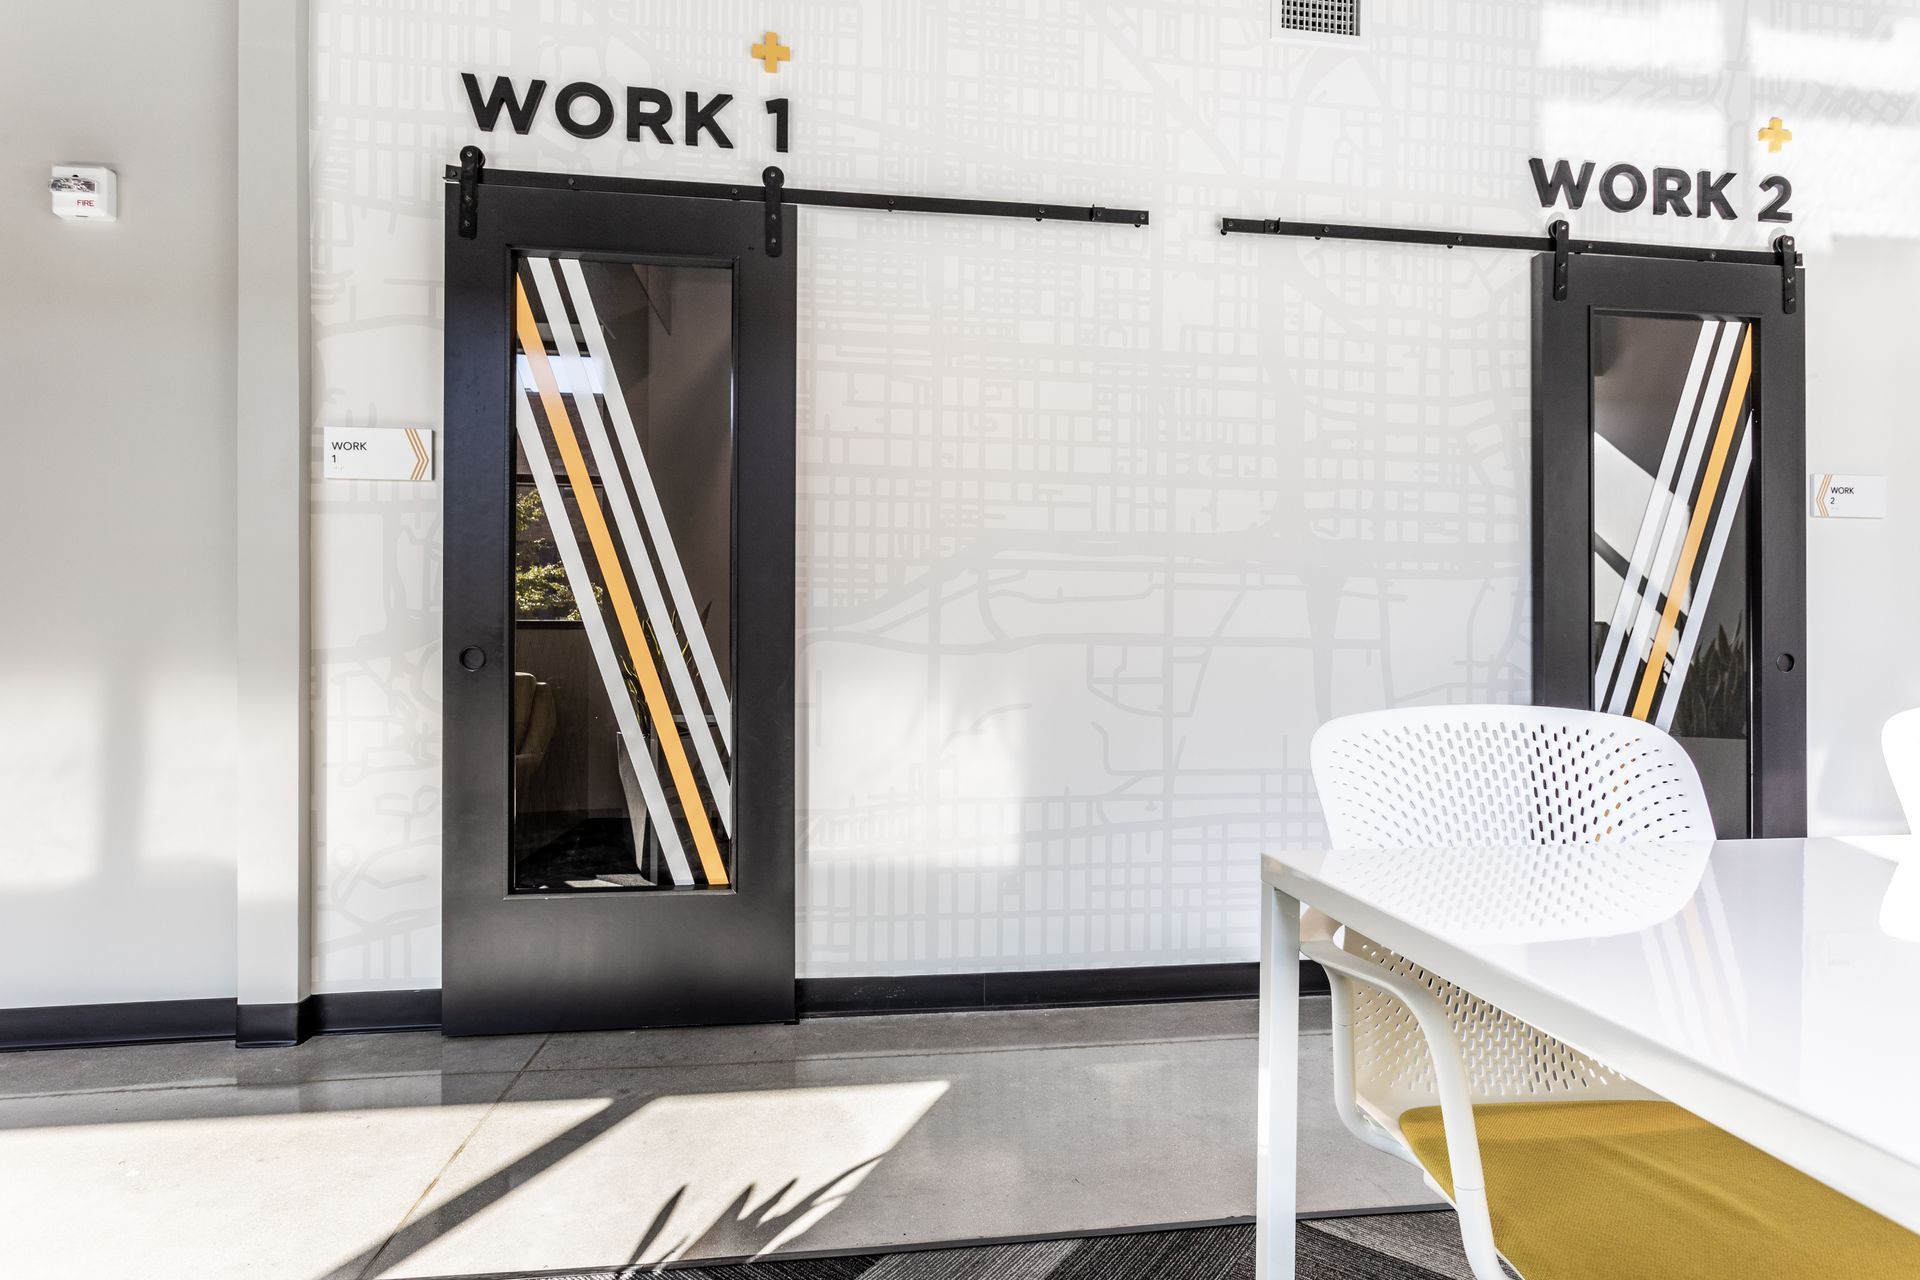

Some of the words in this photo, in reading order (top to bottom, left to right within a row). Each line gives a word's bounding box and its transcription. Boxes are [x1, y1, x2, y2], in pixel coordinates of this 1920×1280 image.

[461, 72, 734, 149] WORK
[766, 97, 791, 153] 1
[1528, 156, 1737, 221] WORK
[1758, 175, 1793, 223] 2
[76, 199, 95, 207] FIRE
[331, 441, 368, 451] WORK
[331, 454, 337, 463] 1
[1830, 486, 1855, 495] WORK
[1830, 497, 1836, 505] 2
